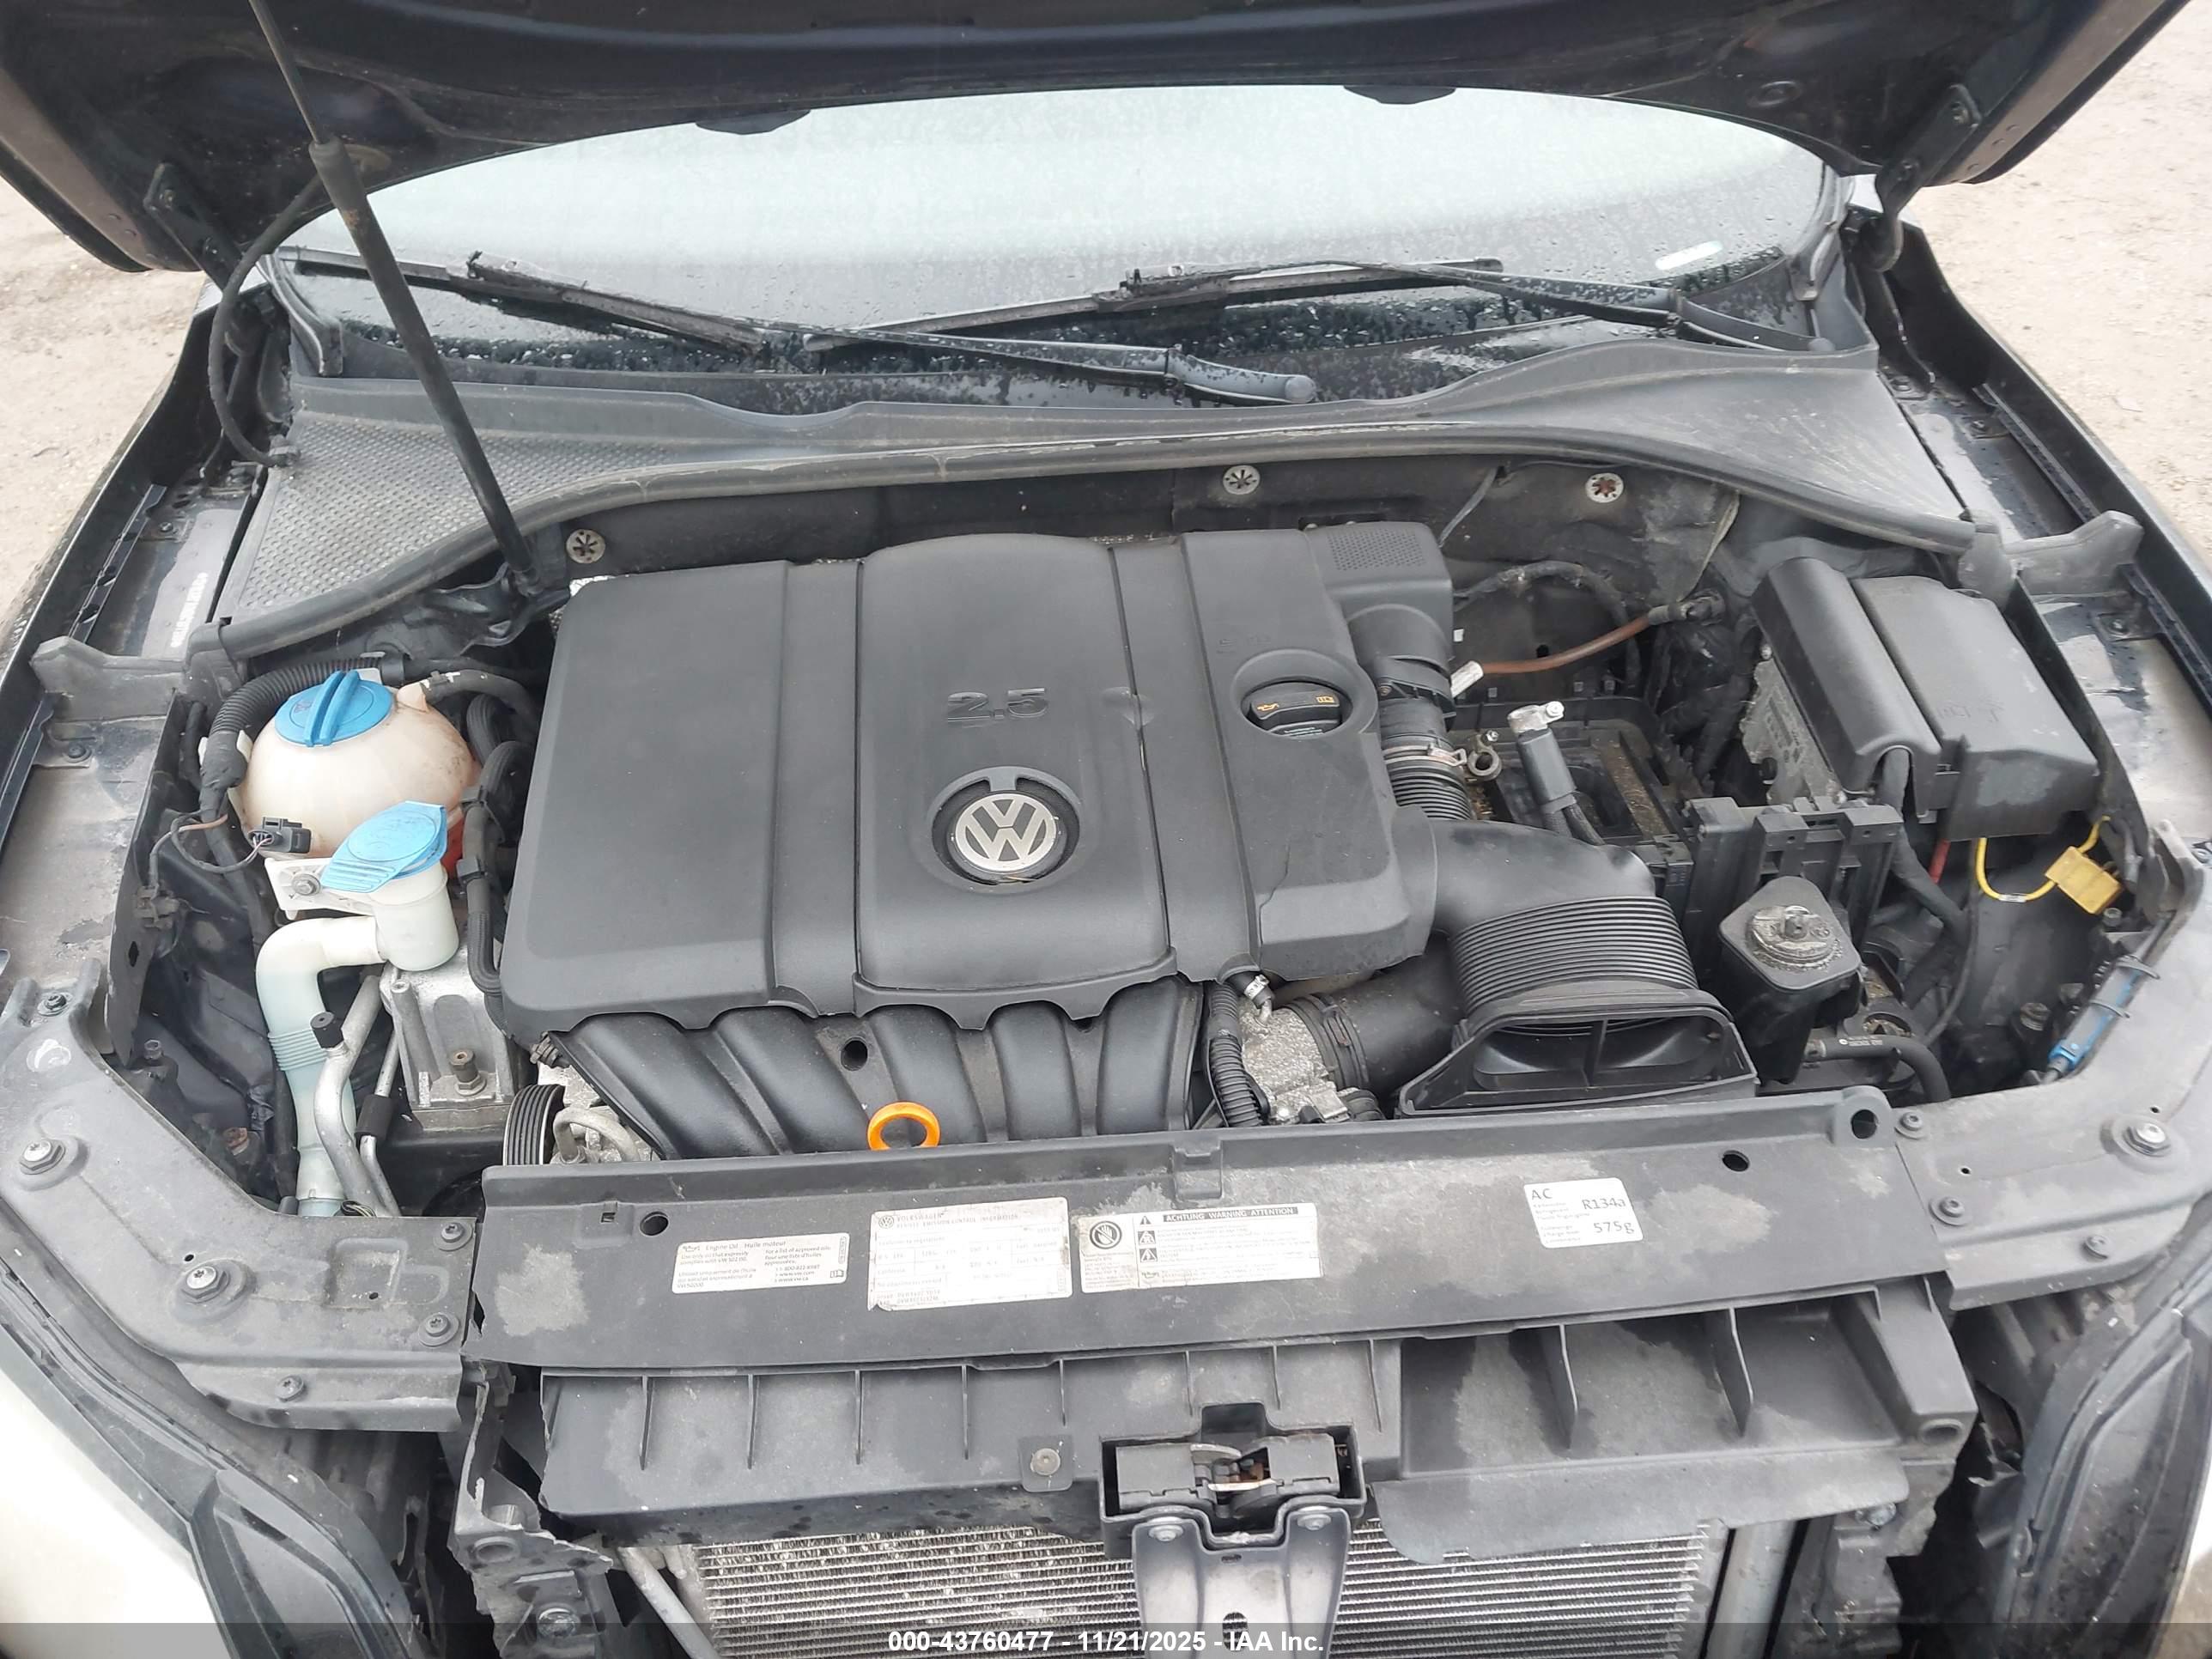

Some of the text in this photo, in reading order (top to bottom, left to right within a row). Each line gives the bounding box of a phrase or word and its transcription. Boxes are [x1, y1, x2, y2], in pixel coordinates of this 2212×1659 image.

[947, 687, 1048, 723] 2.5
[1531, 1188, 1553, 1200] AC
[1582, 1197, 1626, 1210] R134a
[896, 1212, 941, 1222] VOLKSWAGEN
[1166, 1208, 1293, 1222] ACHTUNG WARNING ATTENTION
[1594, 1220, 1635, 1235] 575g
